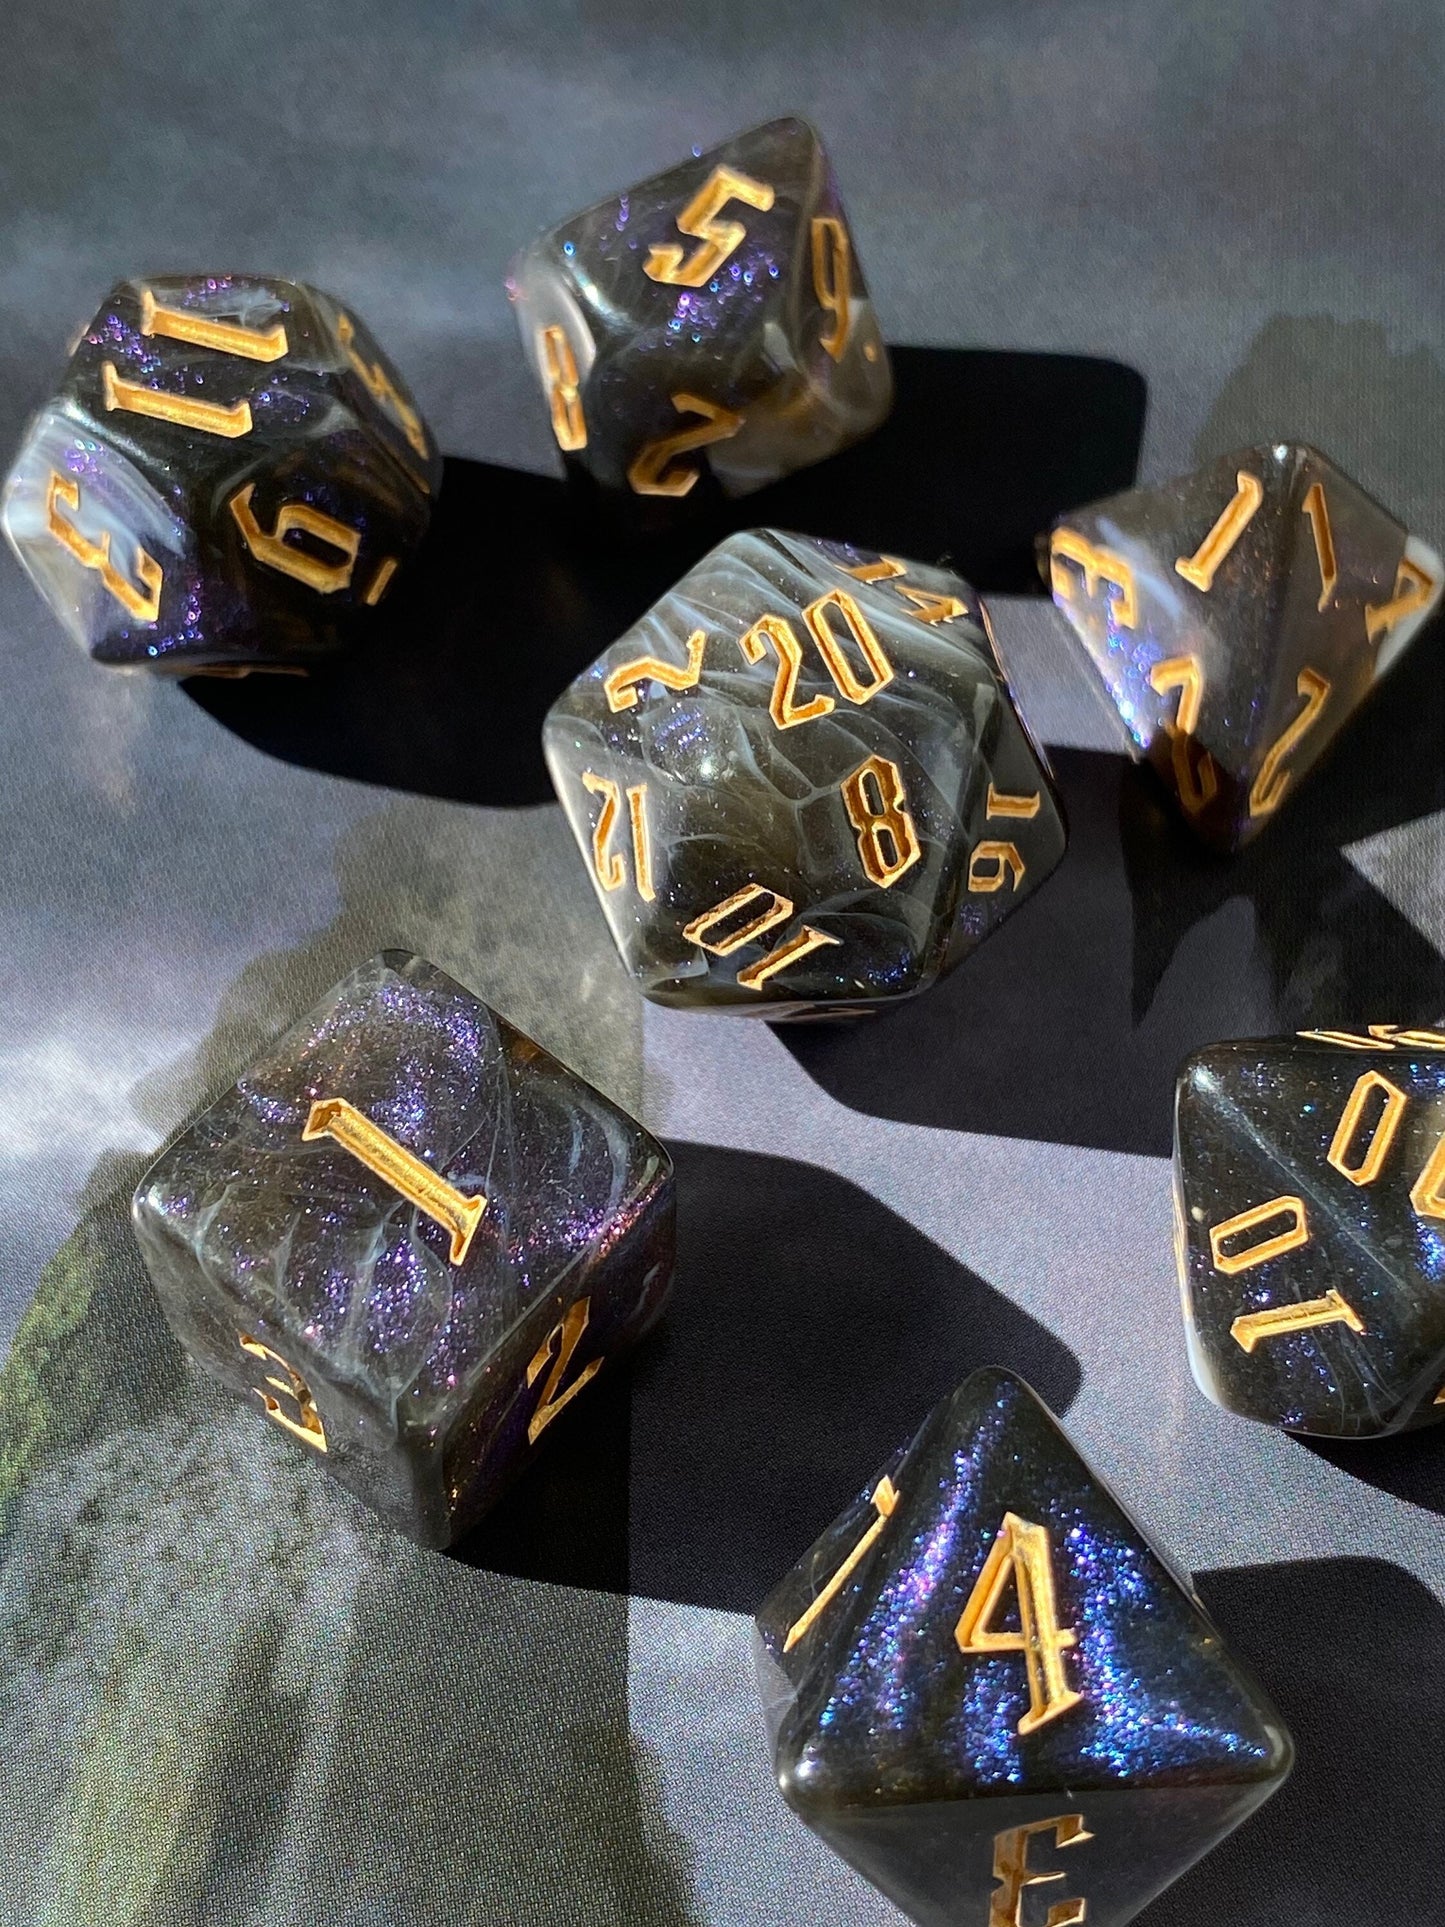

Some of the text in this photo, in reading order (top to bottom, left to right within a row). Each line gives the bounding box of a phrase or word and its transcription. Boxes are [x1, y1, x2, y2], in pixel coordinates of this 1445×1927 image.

[643, 164, 775, 287] 5
[102, 289, 290, 439] 11
[1175, 470, 1263, 592] 1
[739, 587, 894, 731] 20
[839, 753, 922, 889] 8
[301, 1097, 487, 1266] 1
[954, 1511, 1085, 1736] 4
